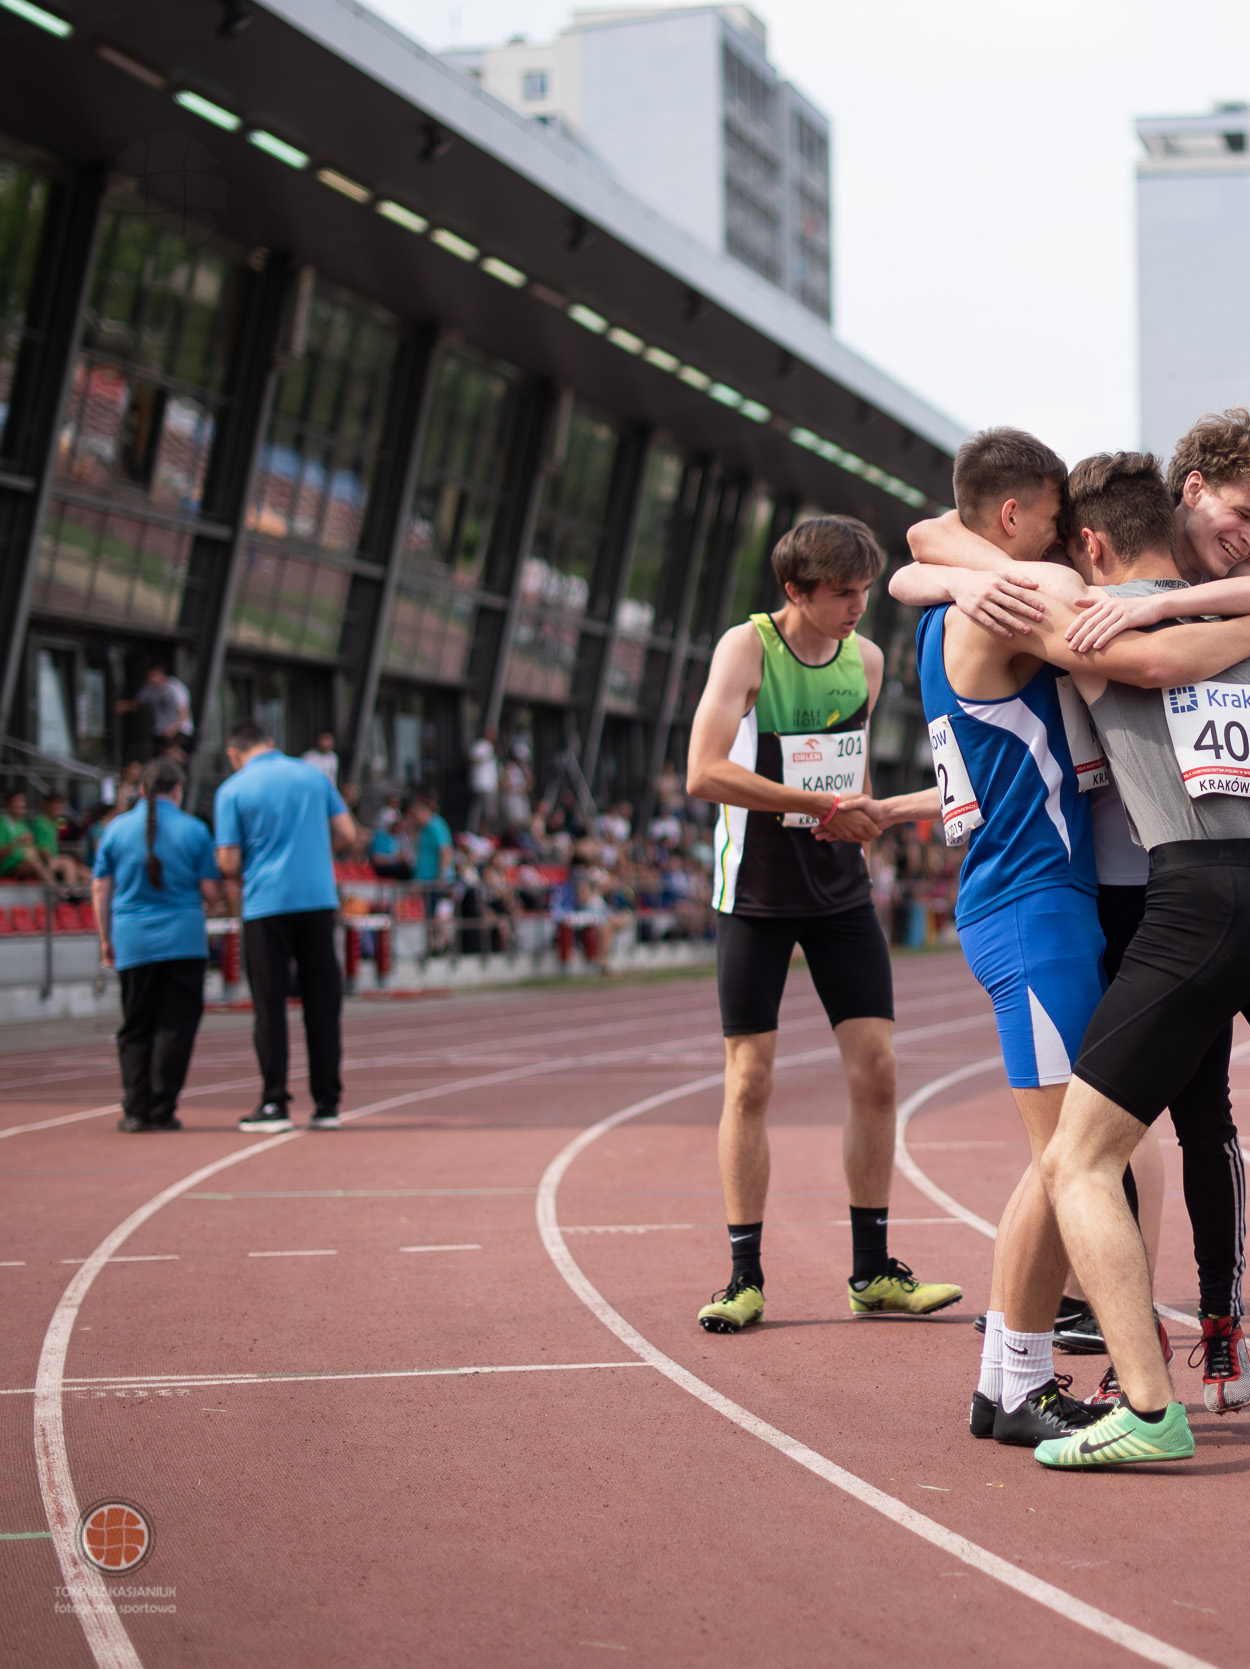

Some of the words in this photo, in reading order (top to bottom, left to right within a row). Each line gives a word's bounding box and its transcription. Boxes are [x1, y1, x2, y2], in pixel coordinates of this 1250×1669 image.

[1154, 580, 1176, 588] NIKE
[837, 735, 863, 757] 101
[794, 752, 821, 761] ORLEN
[802, 772, 855, 792] KAROW
[1199, 777, 1250, 794] KRAKÓW
[799, 816, 818, 826] KRA
